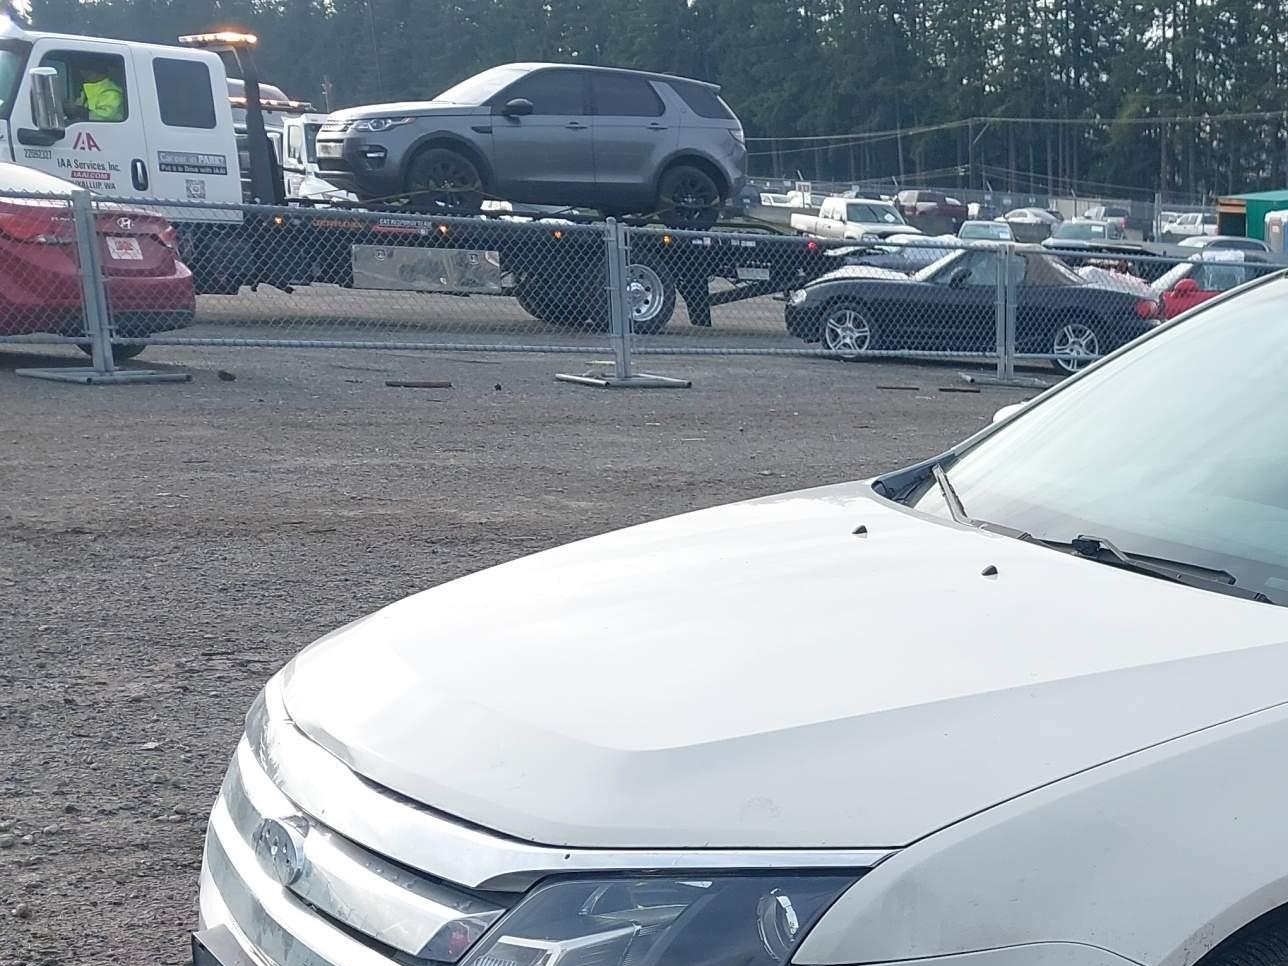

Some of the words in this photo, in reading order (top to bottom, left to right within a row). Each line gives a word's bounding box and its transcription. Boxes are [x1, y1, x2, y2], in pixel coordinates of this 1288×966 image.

[57, 158, 72, 169] IAA
[73, 160, 106, 172] Services,
[108, 162, 120, 172] Inc.
